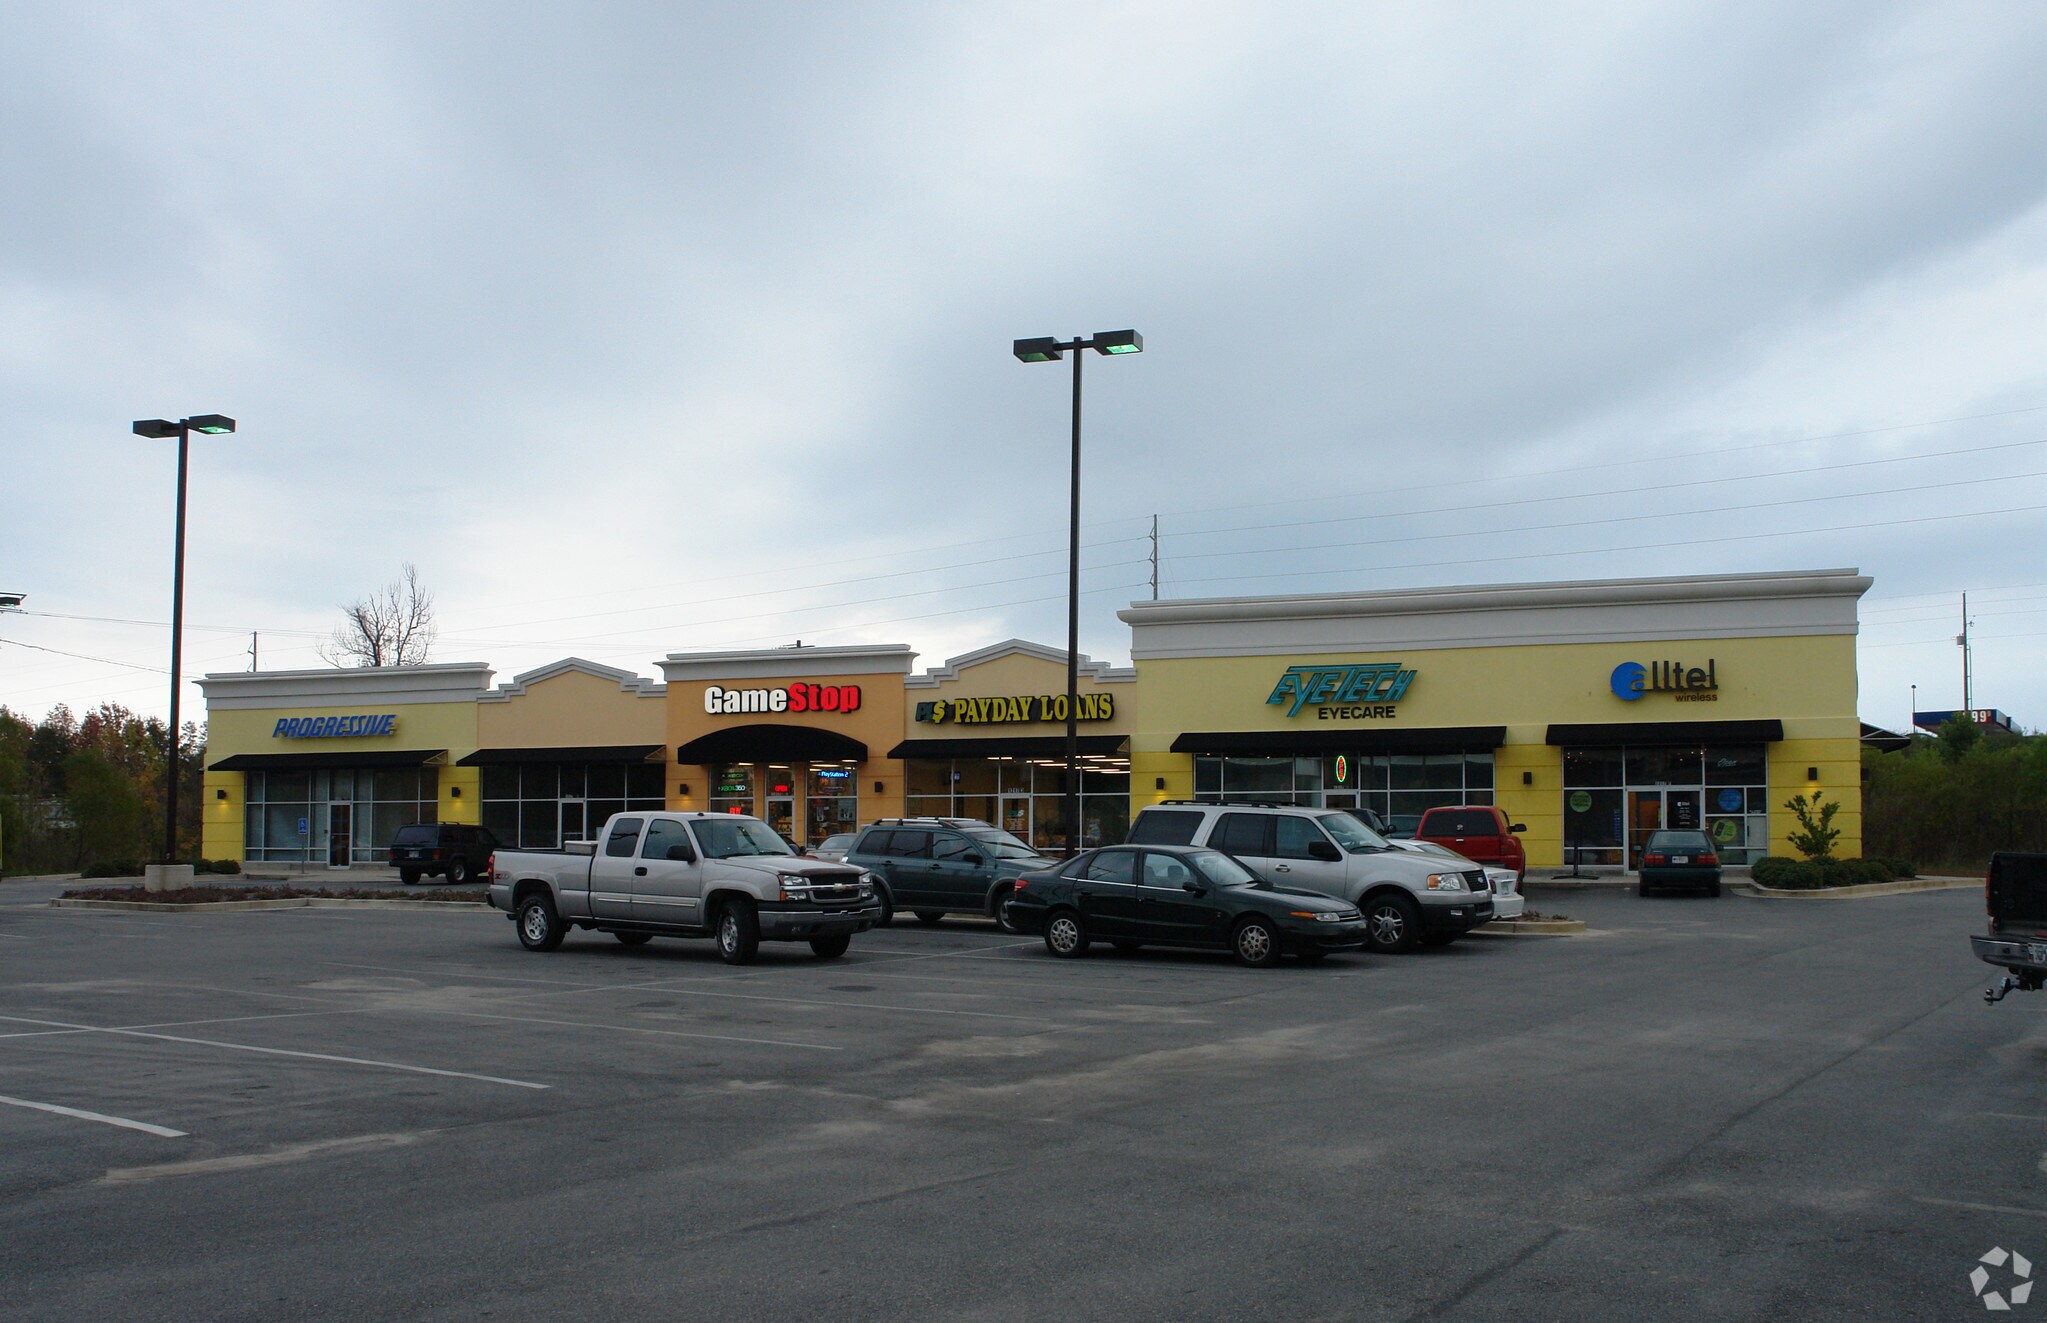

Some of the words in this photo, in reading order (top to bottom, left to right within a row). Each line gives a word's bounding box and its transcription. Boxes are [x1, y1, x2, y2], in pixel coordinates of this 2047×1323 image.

[1628, 659, 1718, 692] alltel
[704, 682, 860, 714] GameStop
[954, 696, 1034, 723] PAYDAY
[1675, 692, 1718, 702] wireless
[1318, 706, 1396, 720] EYECARE
[272, 715, 397, 738] PROGRESSIVE
